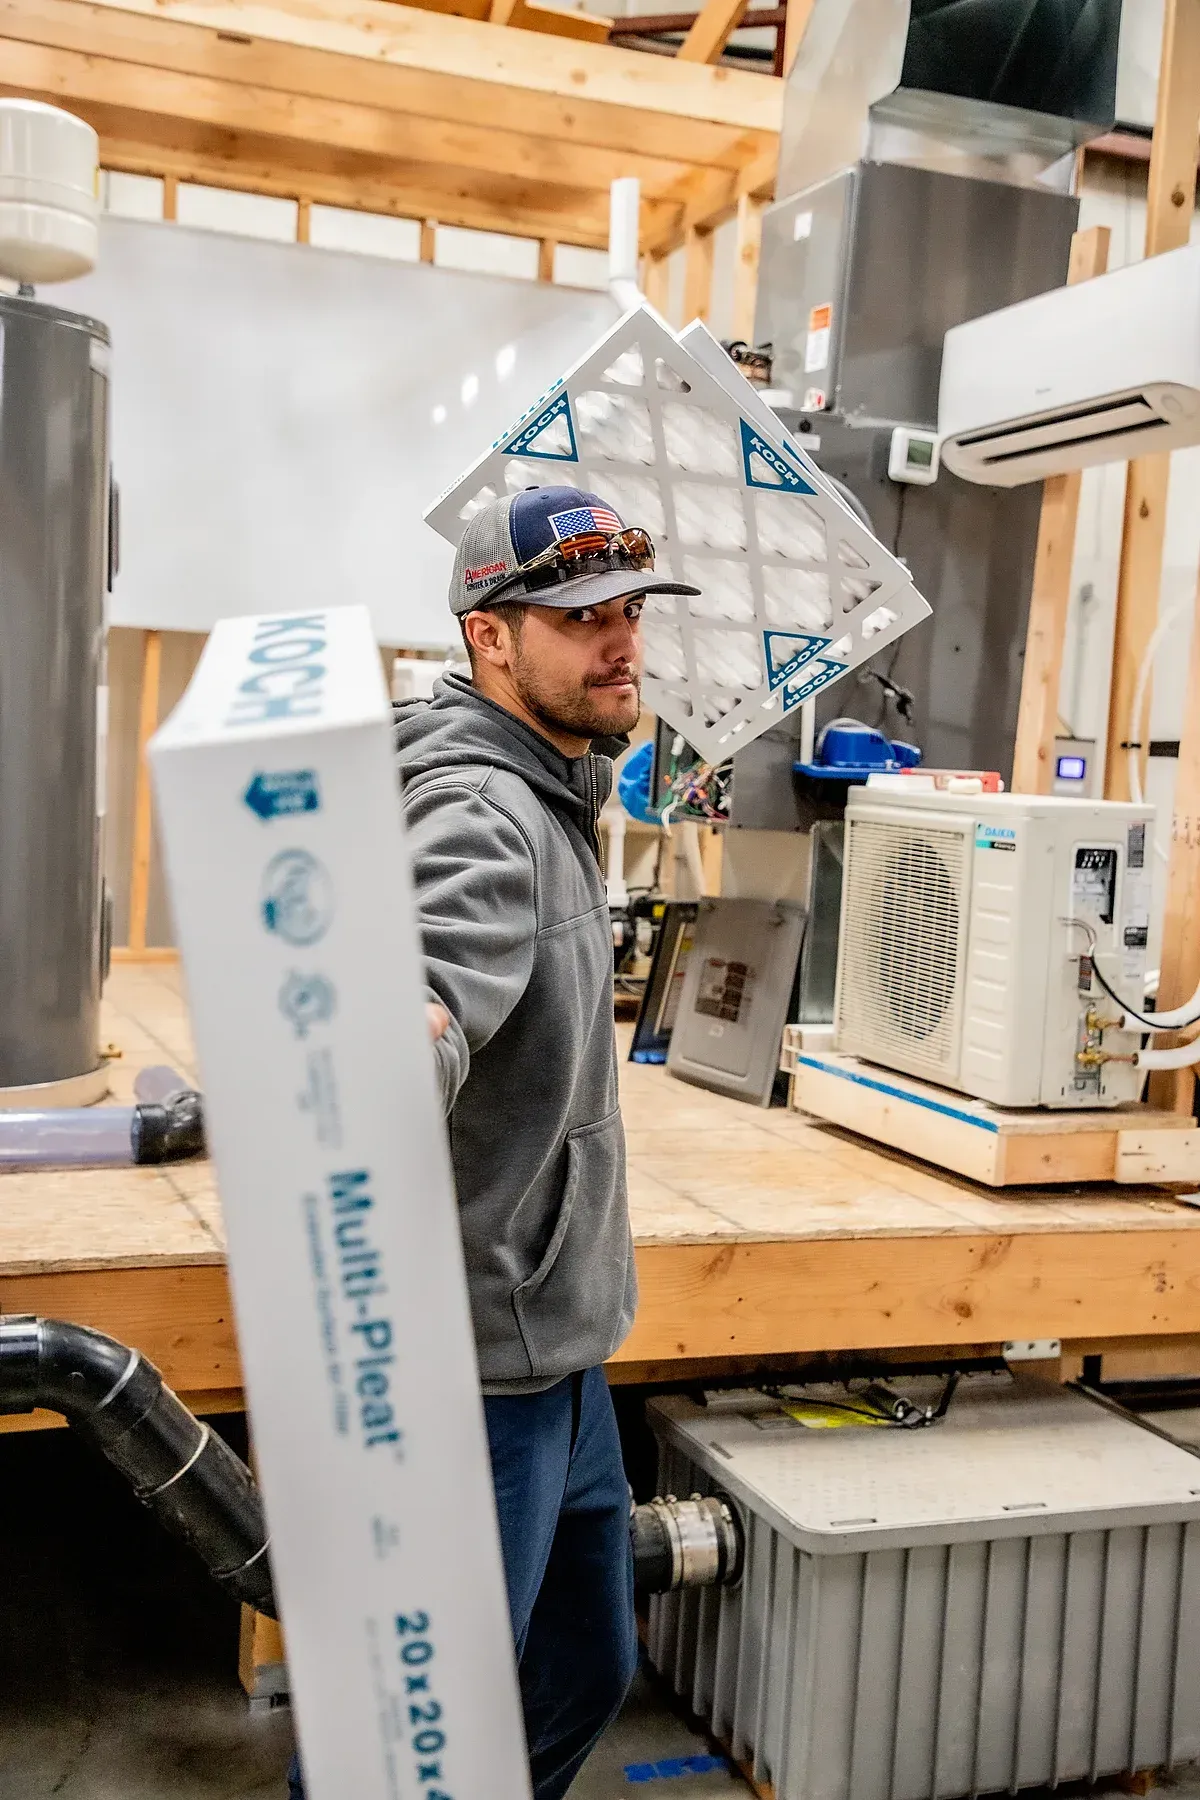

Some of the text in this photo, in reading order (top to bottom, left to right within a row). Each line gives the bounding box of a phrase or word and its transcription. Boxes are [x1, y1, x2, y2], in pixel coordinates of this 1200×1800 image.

[510, 399, 567, 453] KOCH
[749, 437, 799, 486] KOCH
[464, 561, 507, 585] AMERICAN
[223, 613, 328, 728] KOCH
[771, 639, 825, 685] KOCH
[785, 664, 841, 706] KOCH
[984, 827, 1016, 840] DAIKIN
[328, 1168, 404, 1452] Multi-Pleat
